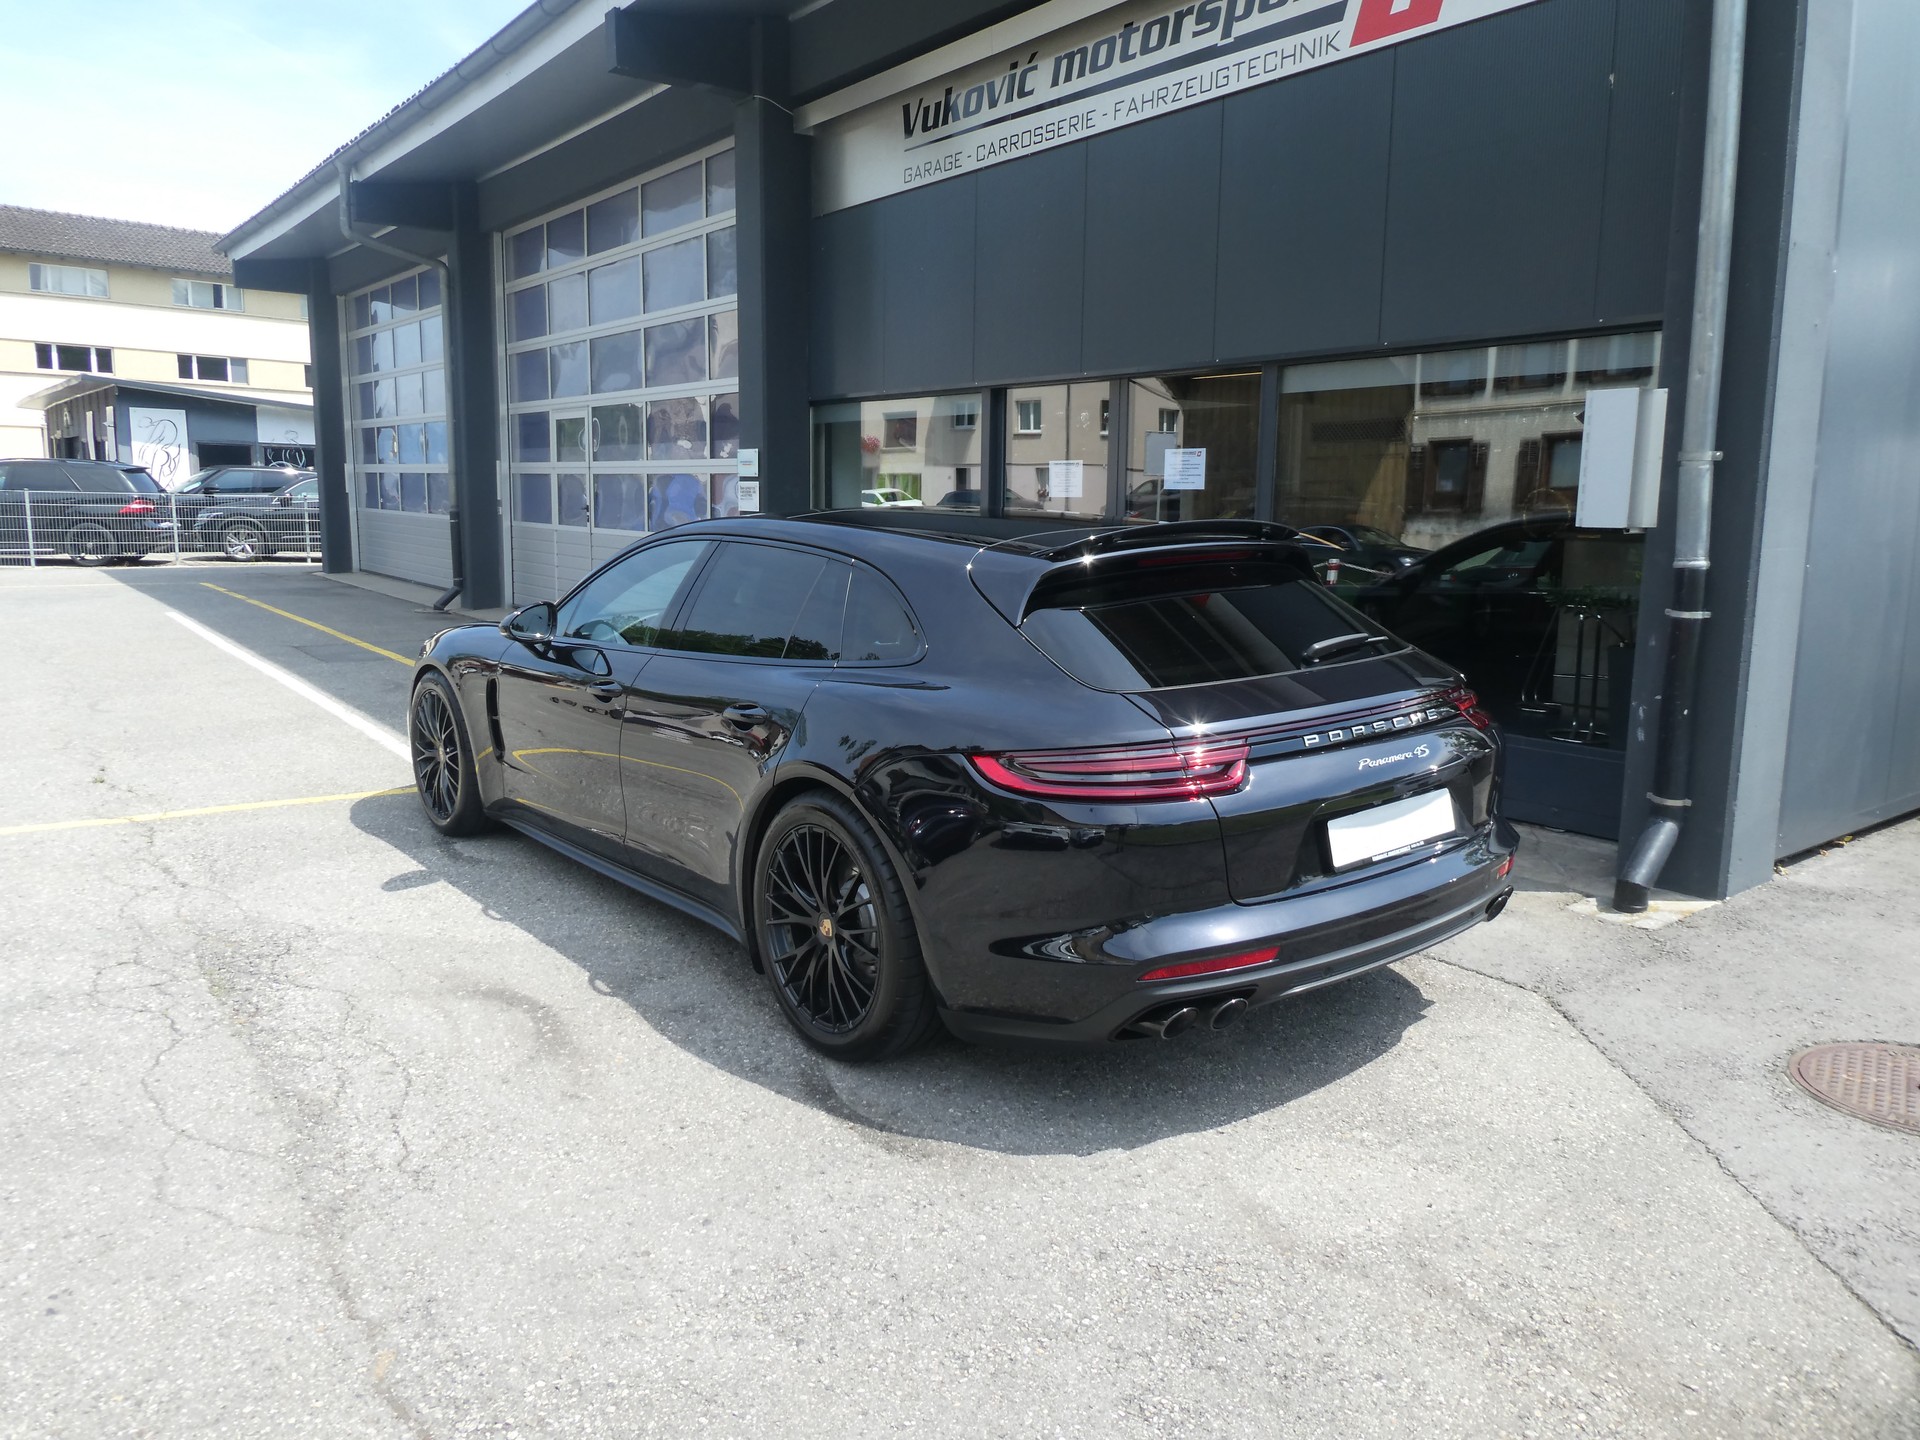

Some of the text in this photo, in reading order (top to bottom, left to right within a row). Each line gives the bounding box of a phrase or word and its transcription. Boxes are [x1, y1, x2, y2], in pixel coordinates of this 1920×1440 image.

[902, 0, 1300, 140] Vuković motorsp
[903, 151, 963, 184] GARAGE
[976, 108, 1097, 163] CARROSSERIE
[1112, 30, 1342, 121] FAHRZEUGTECHNIK
[1303, 708, 1439, 748] PORSCHE
[1357, 743, 1430, 771] Panamera 4S
